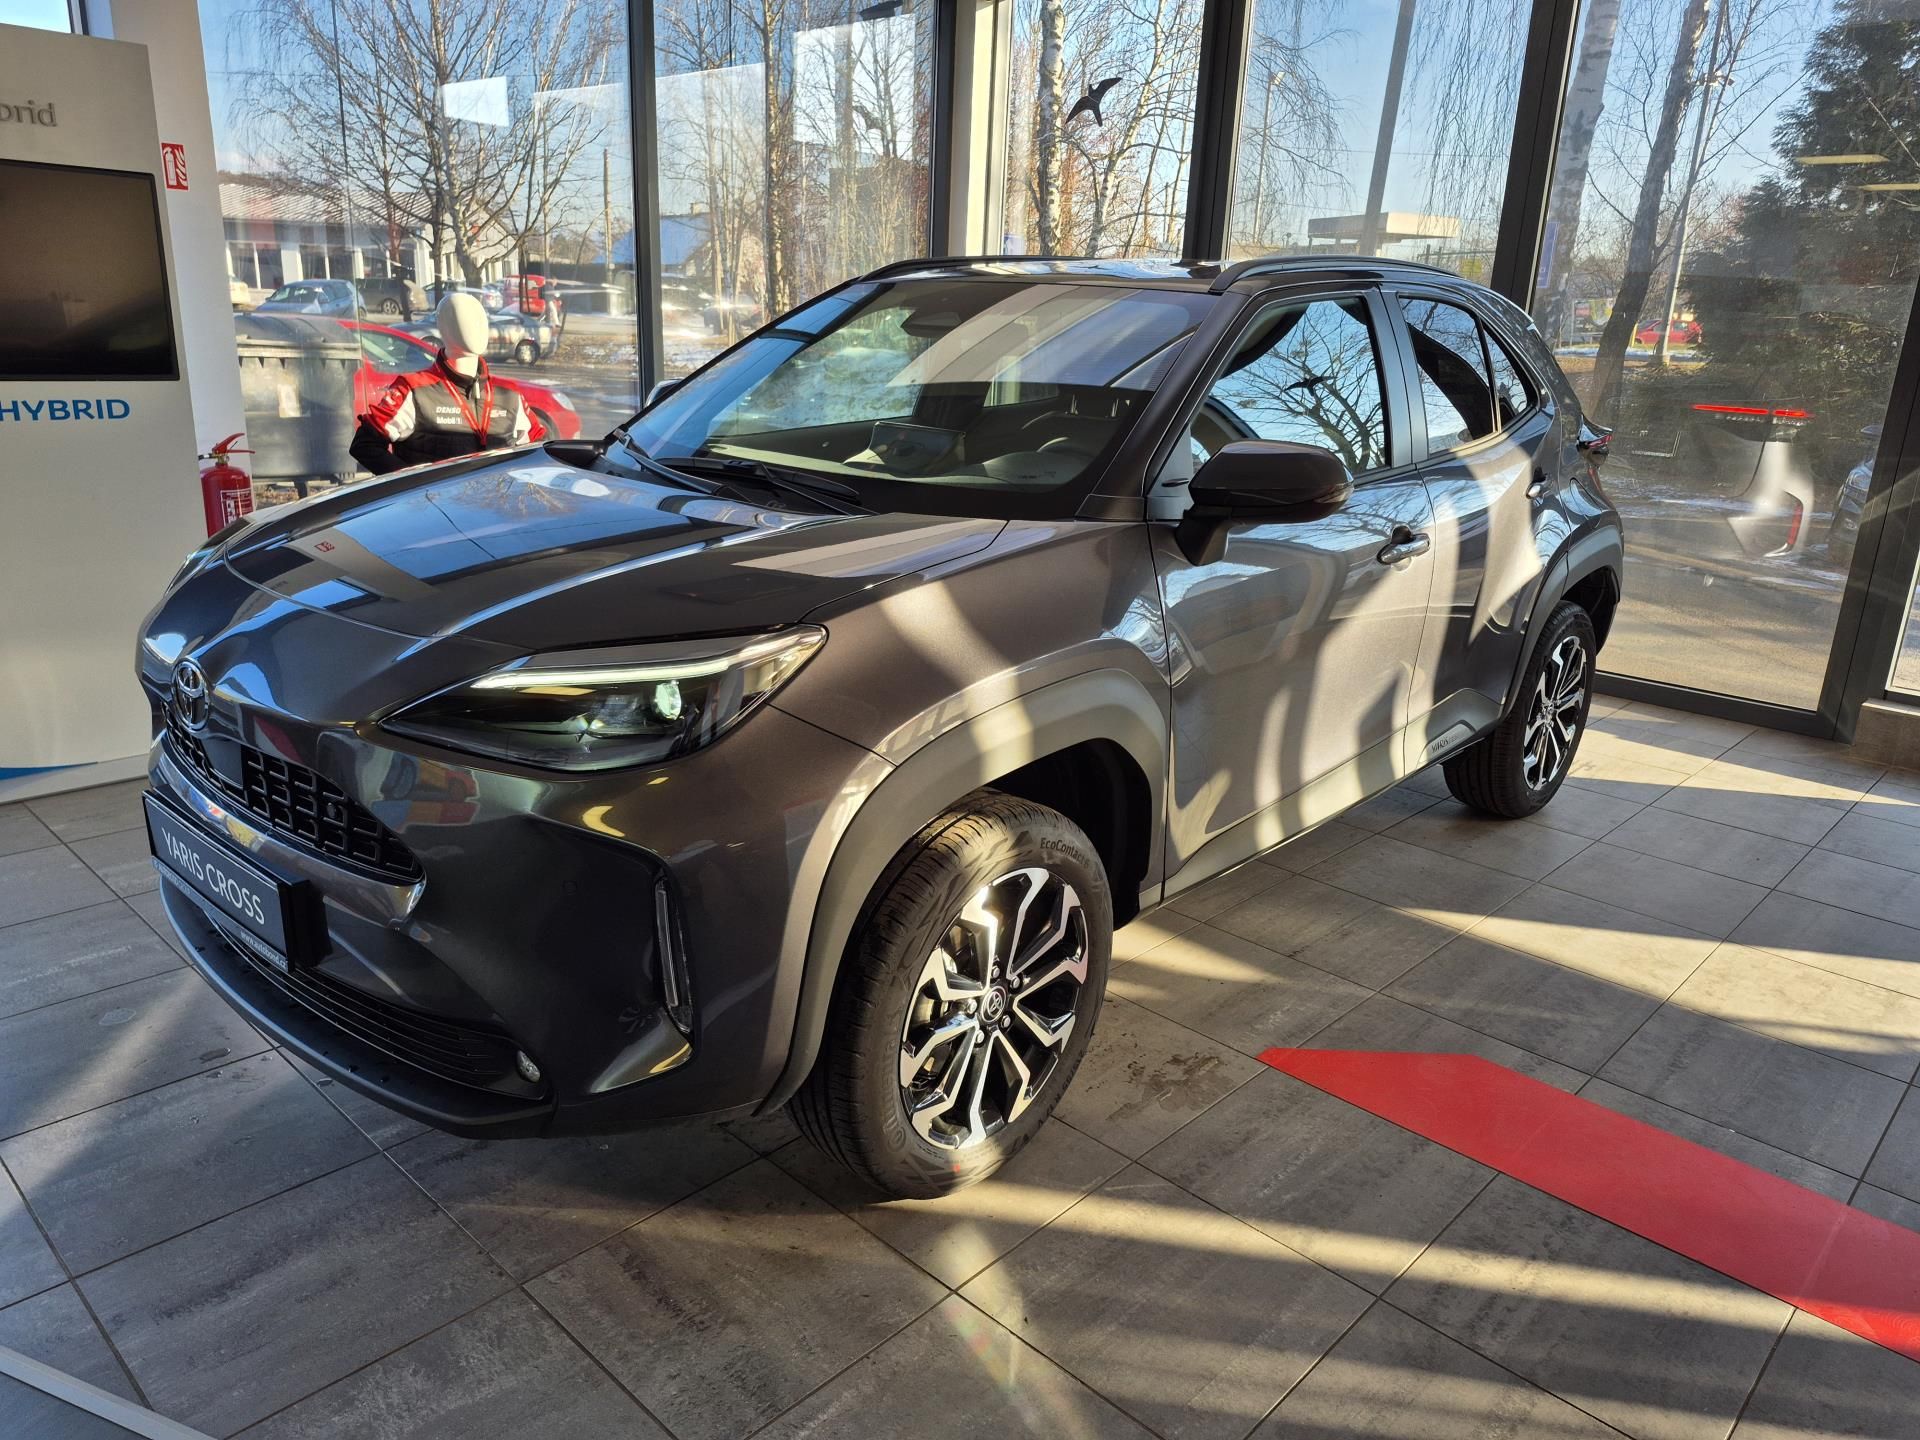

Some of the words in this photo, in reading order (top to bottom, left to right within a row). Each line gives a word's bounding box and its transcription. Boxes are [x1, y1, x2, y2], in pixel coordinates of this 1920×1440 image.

[0, 398, 131, 422] HYBRID
[435, 406, 461, 414] DENSO
[161, 827, 204, 881] YARIS
[205, 863, 265, 925] CROSS
